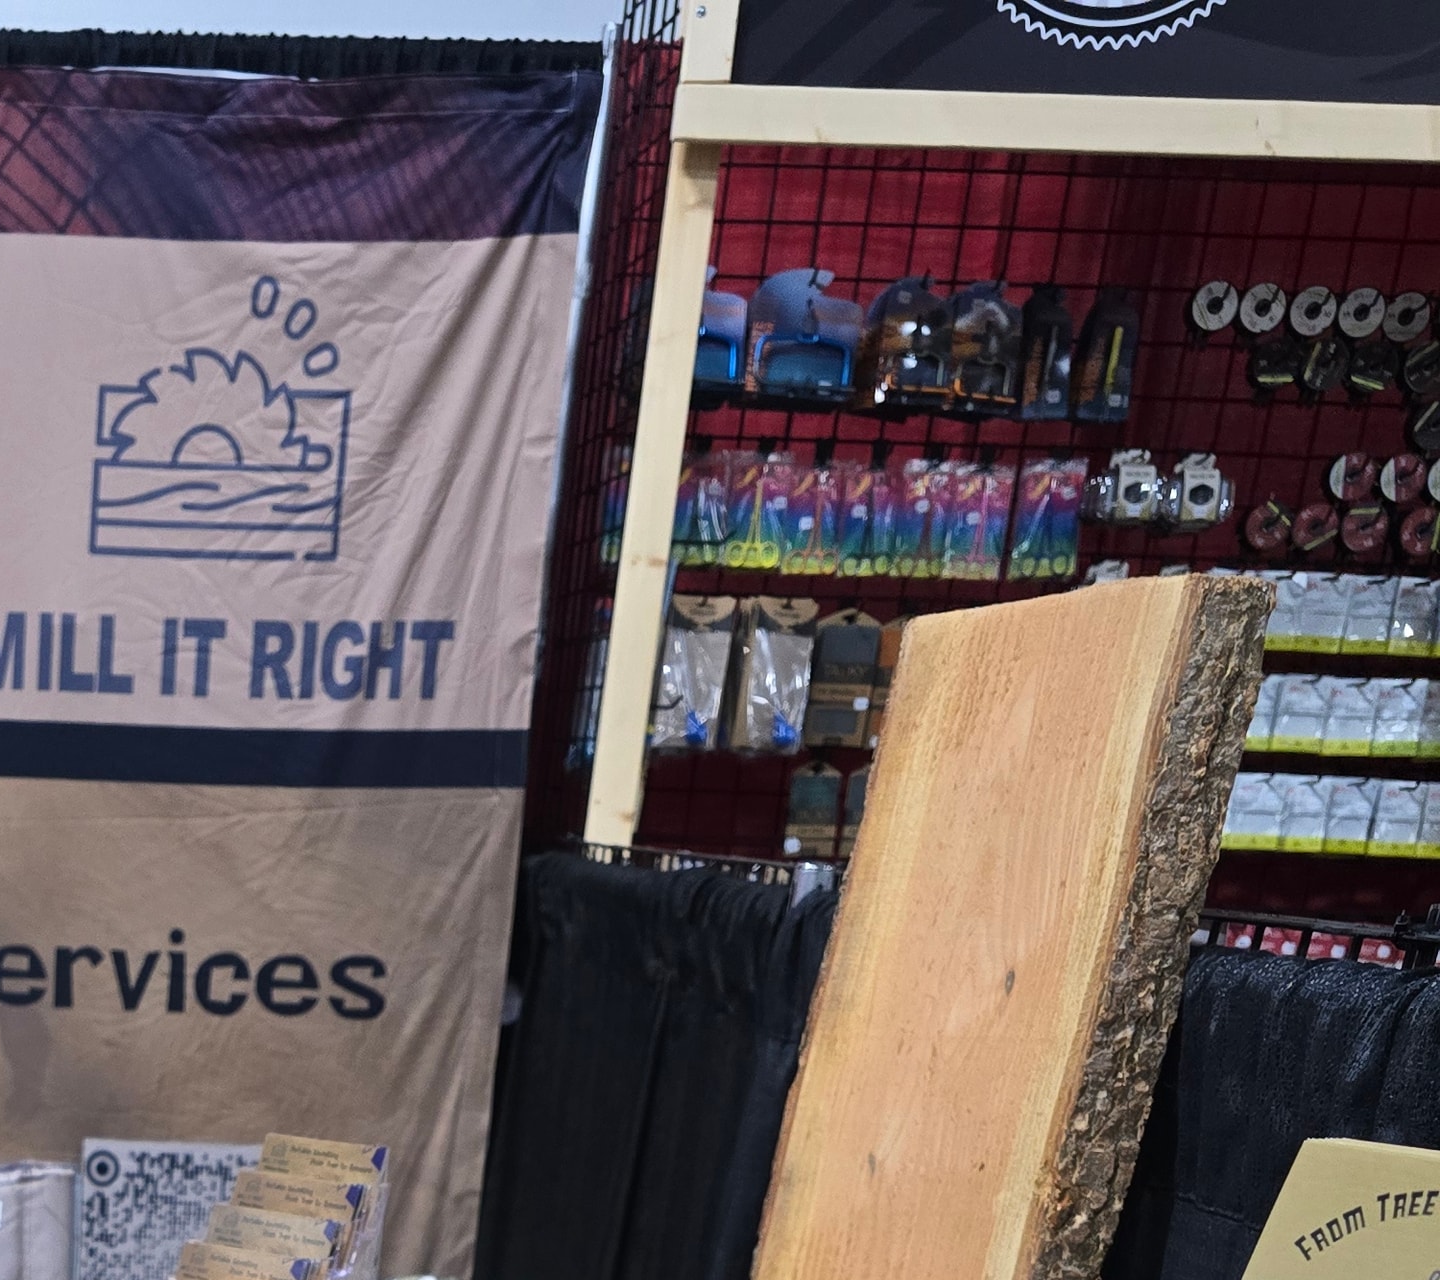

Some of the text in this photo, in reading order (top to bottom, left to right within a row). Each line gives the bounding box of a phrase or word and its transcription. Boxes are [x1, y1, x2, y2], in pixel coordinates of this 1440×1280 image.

[160, 616, 228, 699] IT
[250, 618, 457, 702] RIGHT
[1294, 1190, 1440, 1261] FROM TREE
